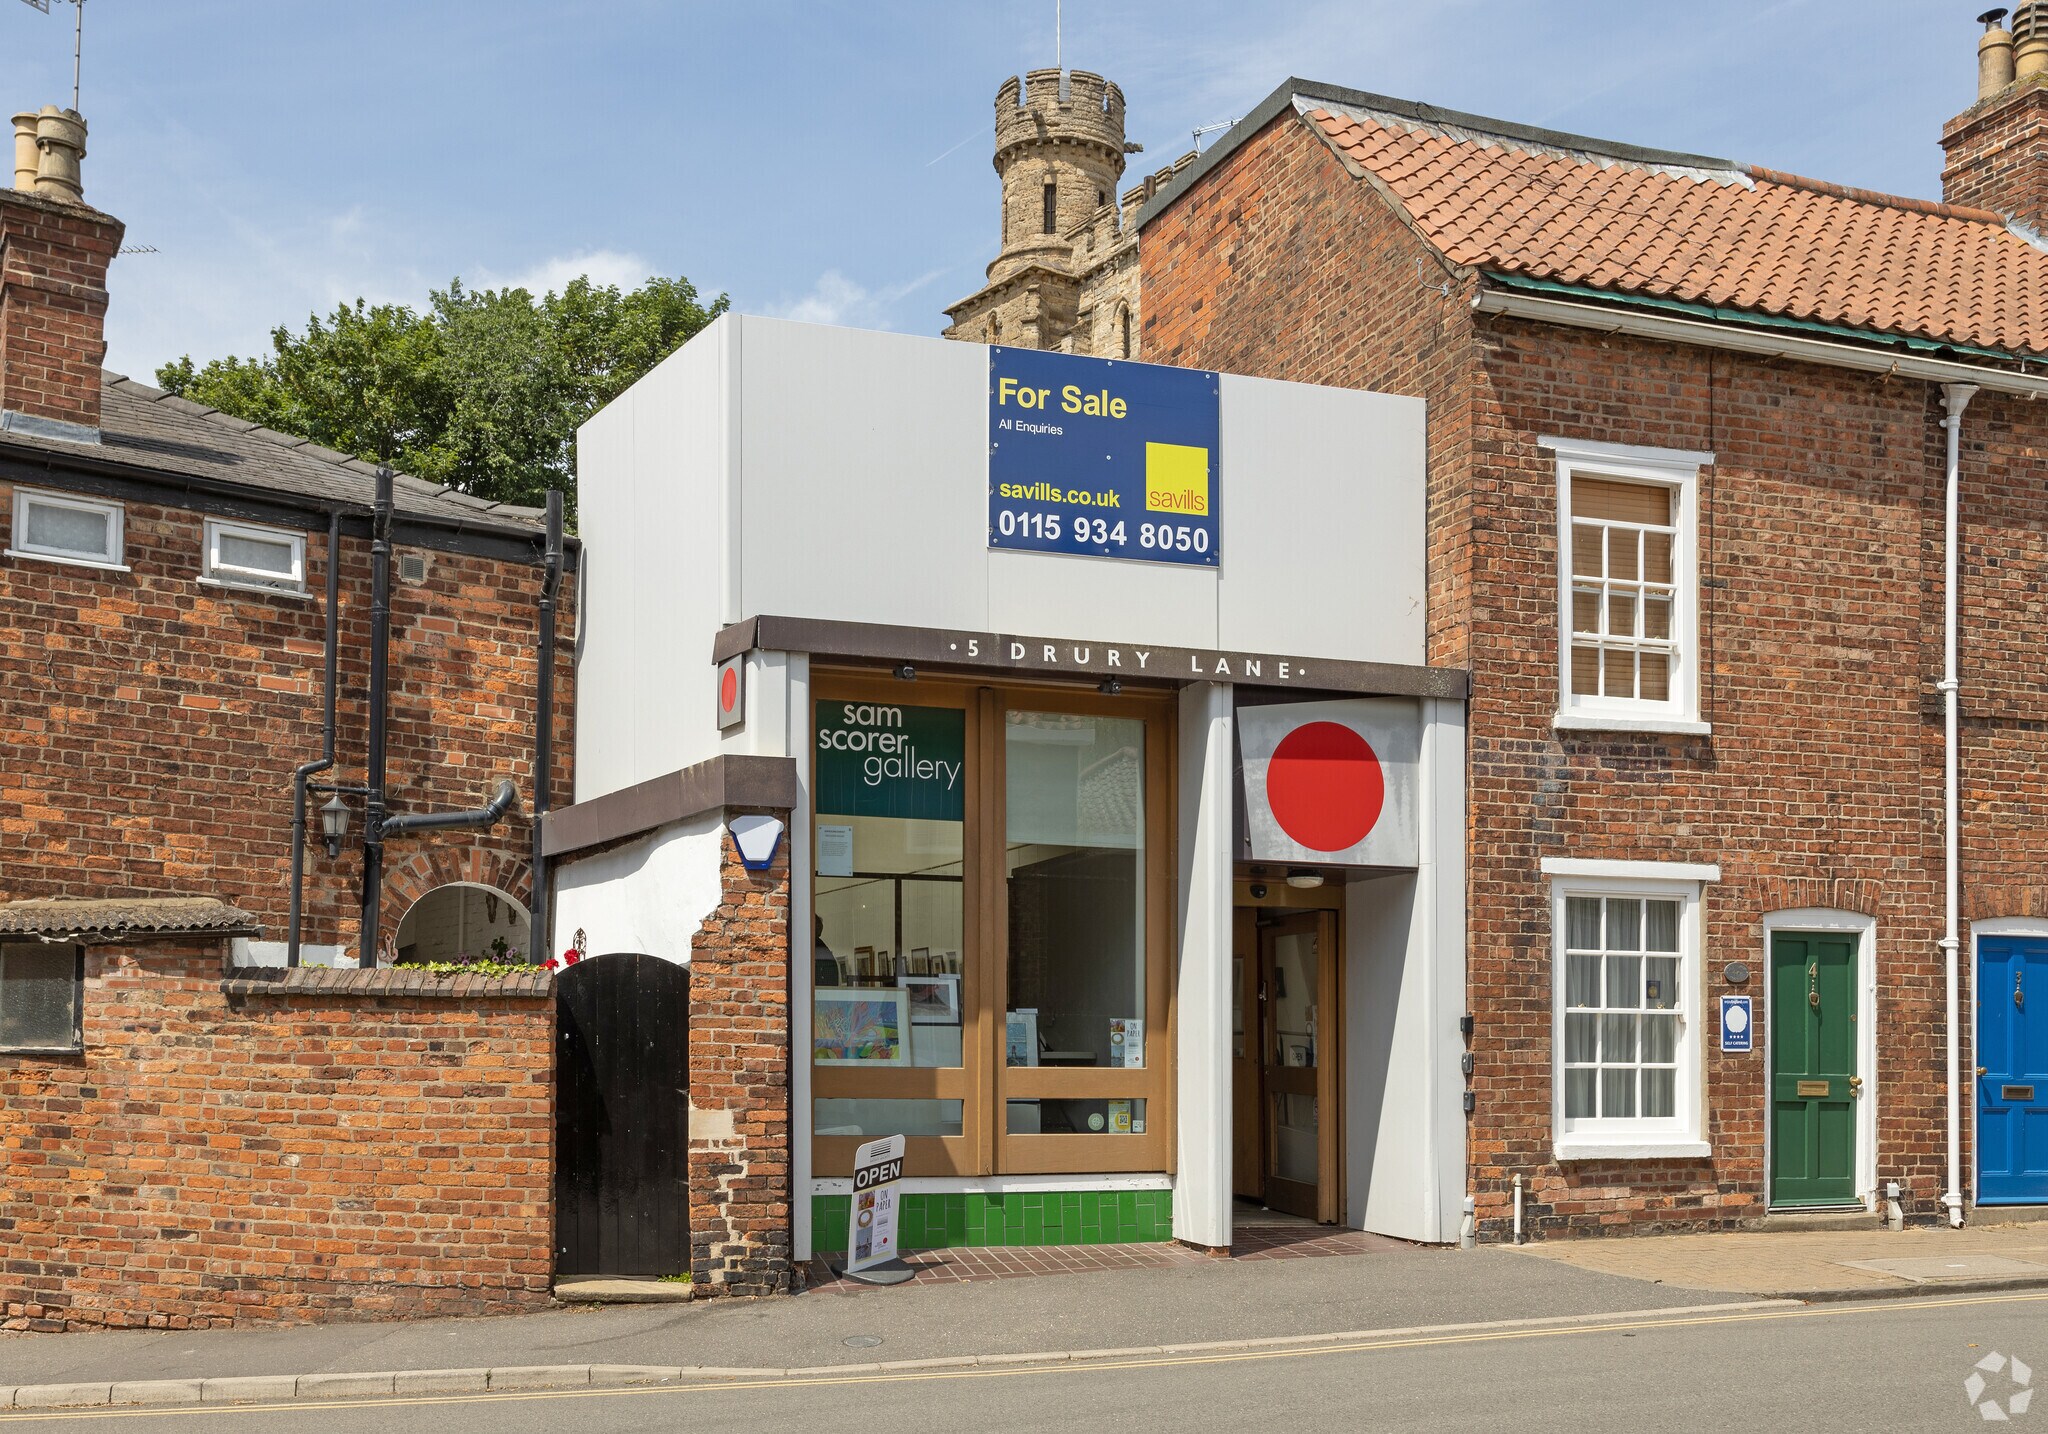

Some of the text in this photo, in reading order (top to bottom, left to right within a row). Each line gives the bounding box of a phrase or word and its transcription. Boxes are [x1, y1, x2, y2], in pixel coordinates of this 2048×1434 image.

[999, 377, 1127, 419] For Sale
[998, 418, 1063, 436] All Enquiries
[999, 481, 1121, 508] savills.co.uk
[1149, 490, 1205, 512] savills
[998, 509, 1209, 553] 0115 934 8050
[1010, 642, 1150, 669] DRURY
[1191, 655, 1290, 679] LANE
[843, 704, 902, 727] sam
[818, 728, 909, 754] scorer
[863, 745, 961, 791] gallery
[1808, 962, 1817, 978] 4
[2016, 971, 2023, 983] 3
[856, 1161, 900, 1187] OPEN
[876, 1199, 891, 1211] PAPER
[880, 1188, 889, 1201] ON
